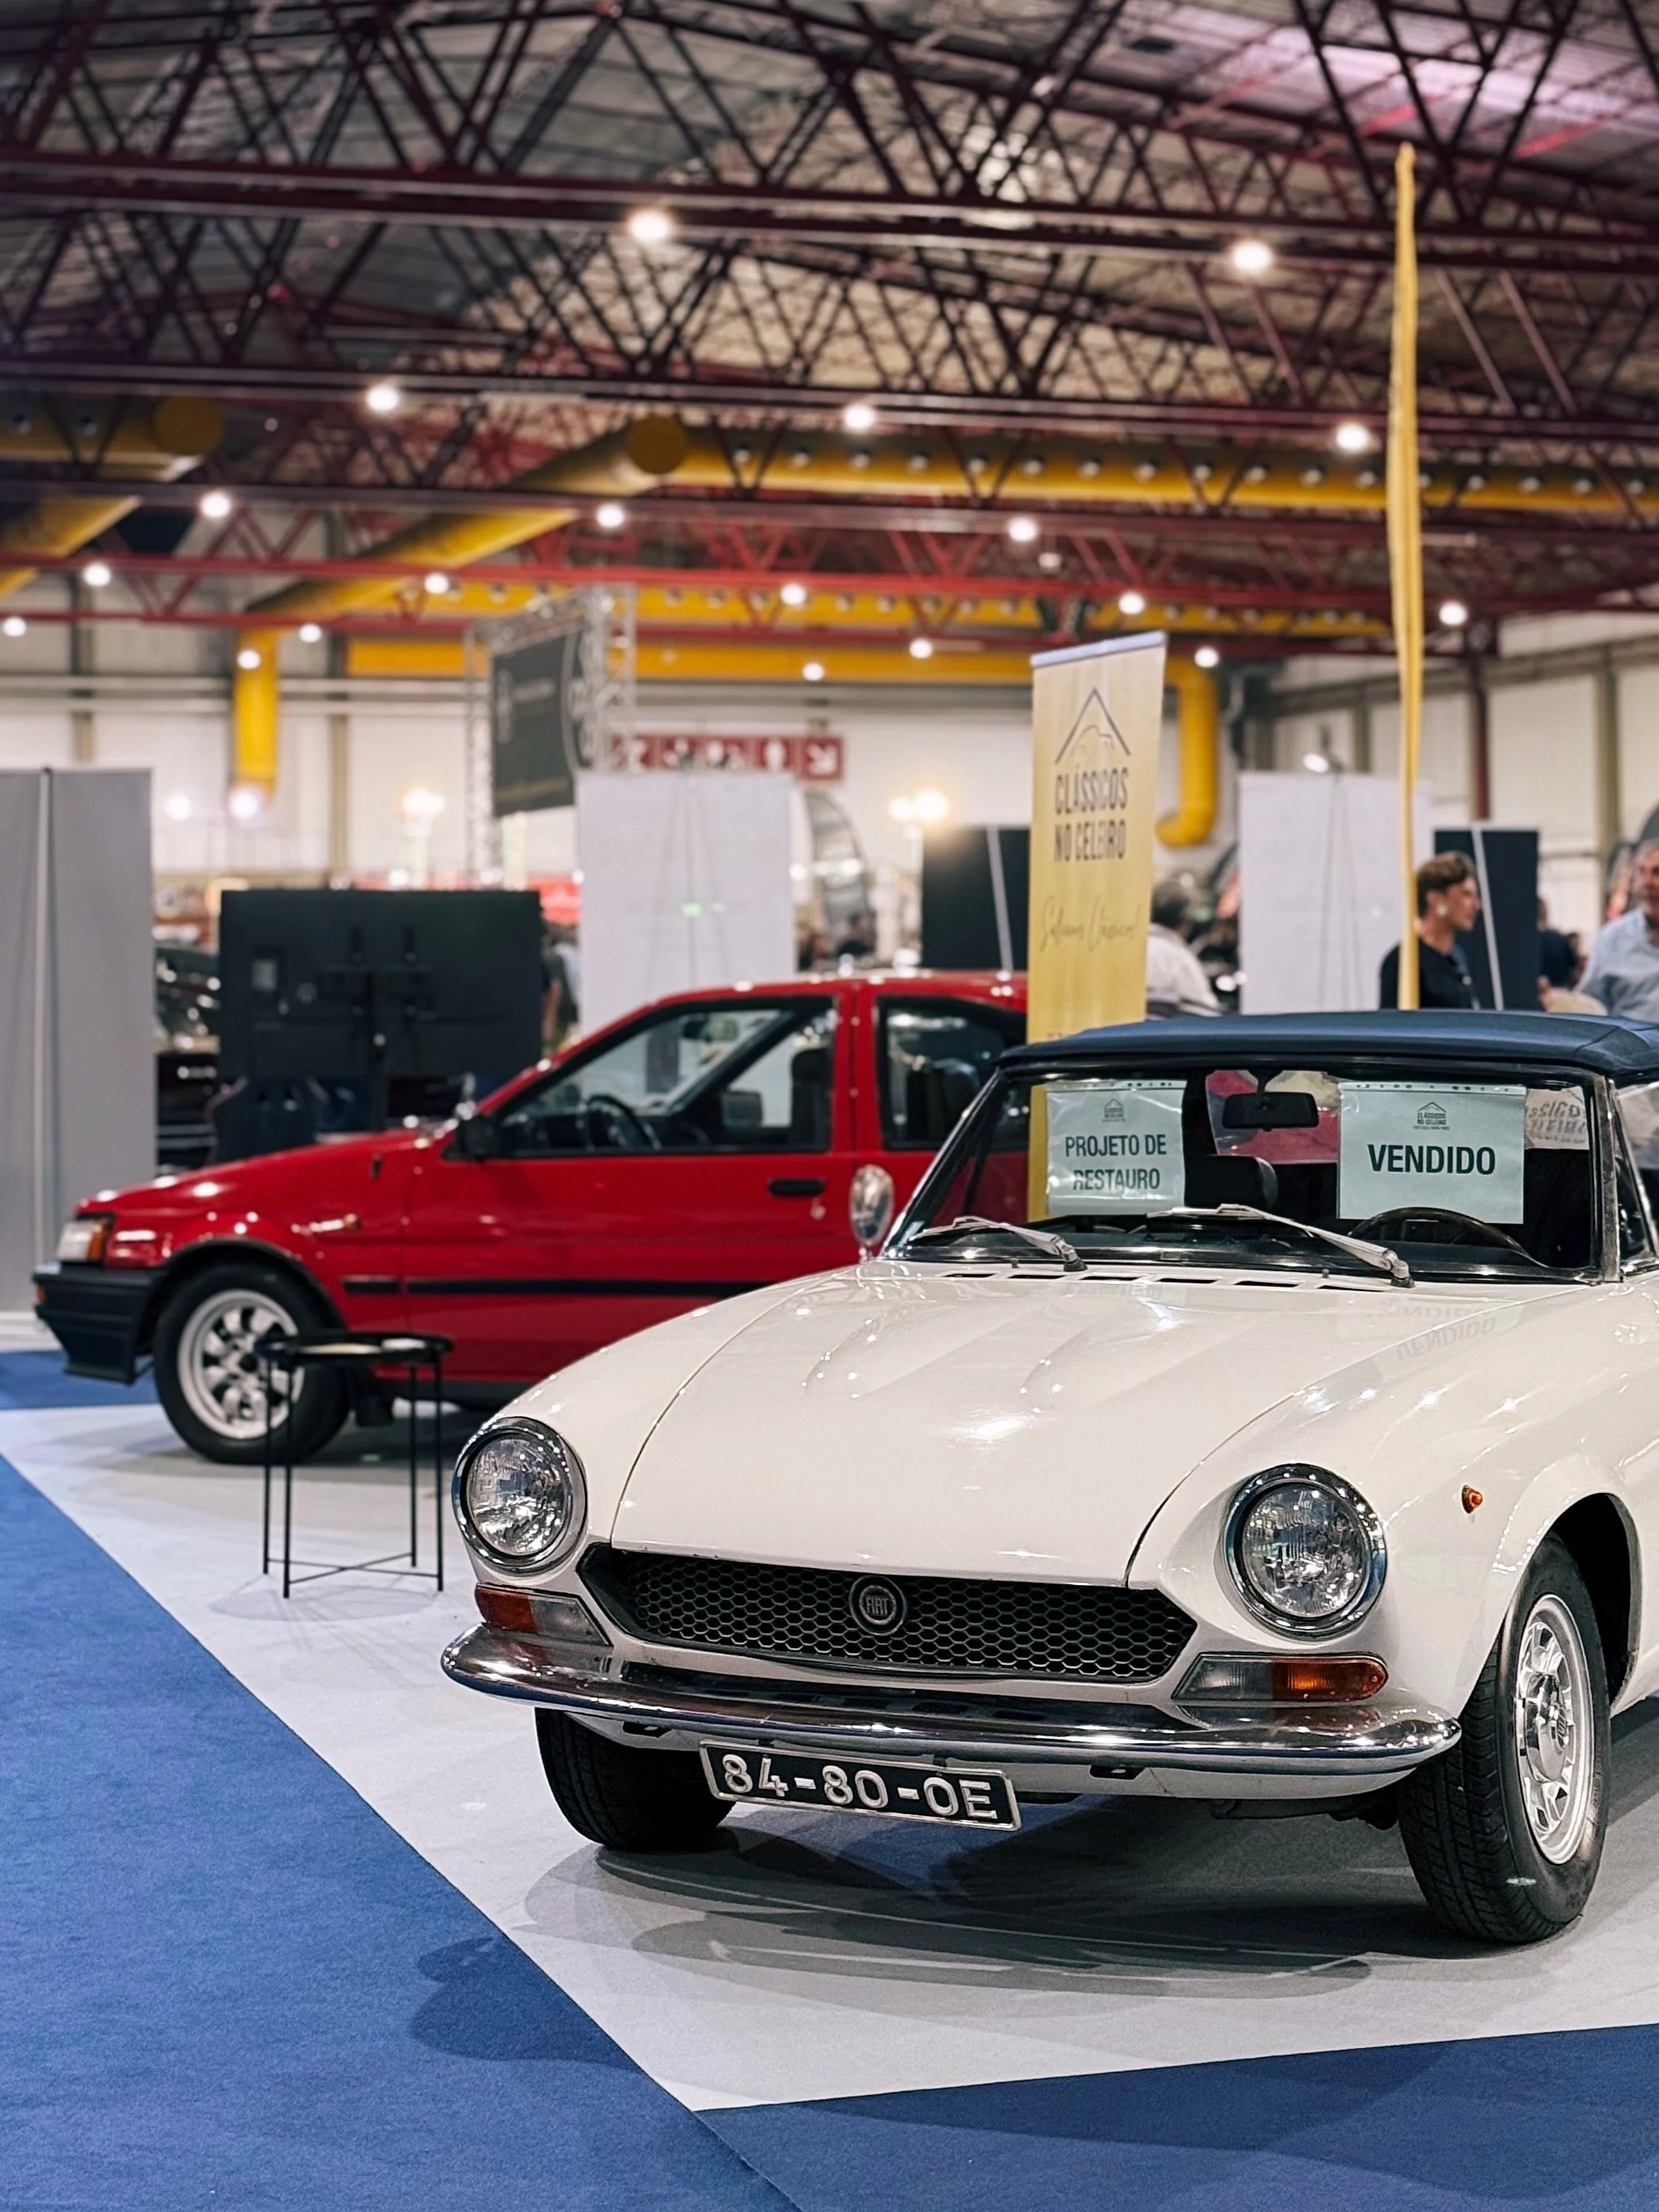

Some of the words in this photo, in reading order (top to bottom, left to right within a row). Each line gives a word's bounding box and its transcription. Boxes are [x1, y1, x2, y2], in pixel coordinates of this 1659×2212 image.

[1053, 823, 1072, 862] NO
[1075, 819, 1126, 862] CELEIRO
[1065, 1135, 1140, 1156] PROJETO
[1145, 1134, 1167, 1156] DE
[1367, 1144, 1496, 1175] VENDIDO
[1072, 1168, 1161, 1191] RESTAURO
[866, 1597, 889, 1615] FIAT
[721, 1753, 998, 1819] 84-80-OE
